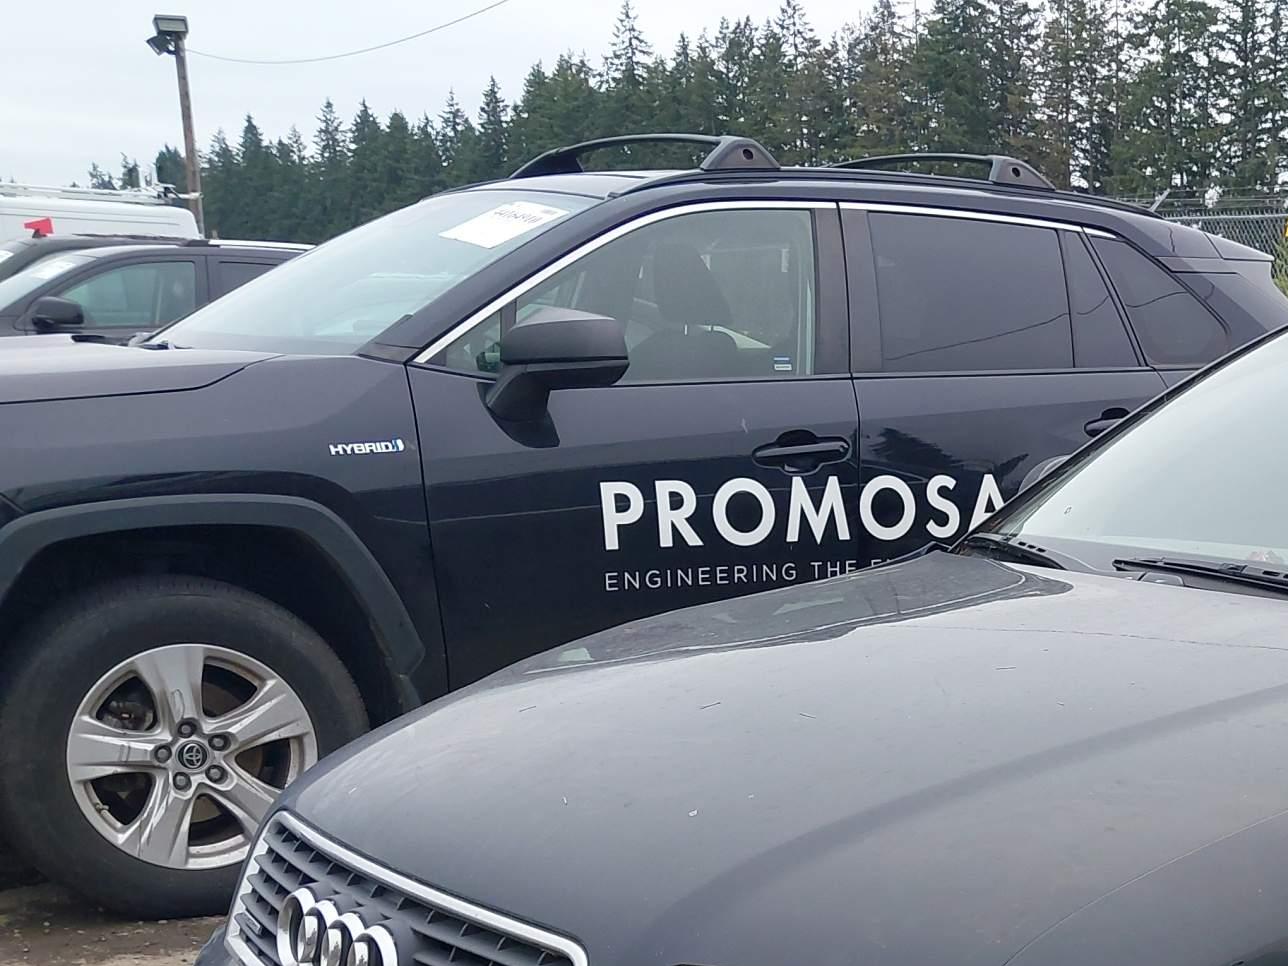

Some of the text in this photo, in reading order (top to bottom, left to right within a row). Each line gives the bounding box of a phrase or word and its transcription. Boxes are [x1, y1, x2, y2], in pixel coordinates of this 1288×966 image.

[329, 441, 394, 455] HYBRID
[600, 473, 1005, 550] PROMOSA
[605, 560, 857, 591] ENGINEERING THE
